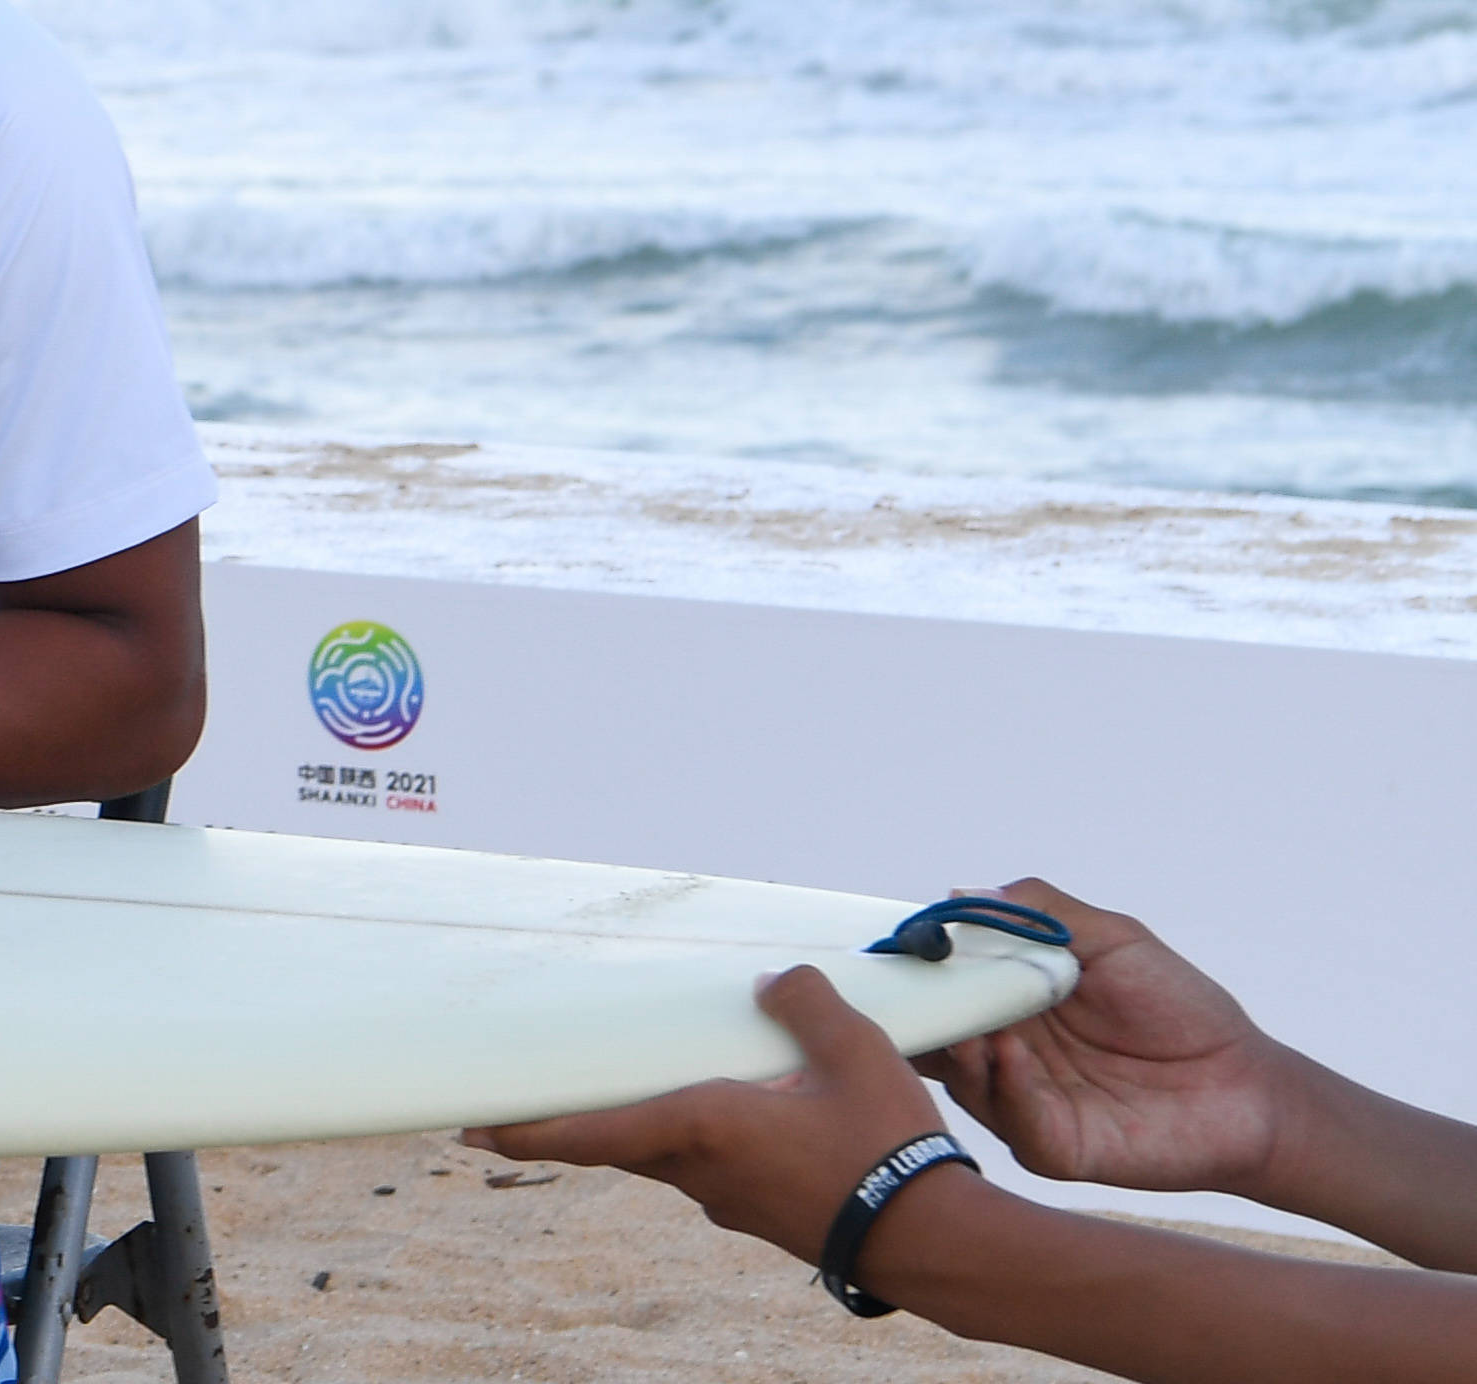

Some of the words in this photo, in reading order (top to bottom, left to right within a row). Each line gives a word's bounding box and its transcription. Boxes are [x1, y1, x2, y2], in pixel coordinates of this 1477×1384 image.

[386, 770, 436, 795] 2021
[297, 786, 377, 808] SHAANXI
[386, 795, 437, 812] CHINA
